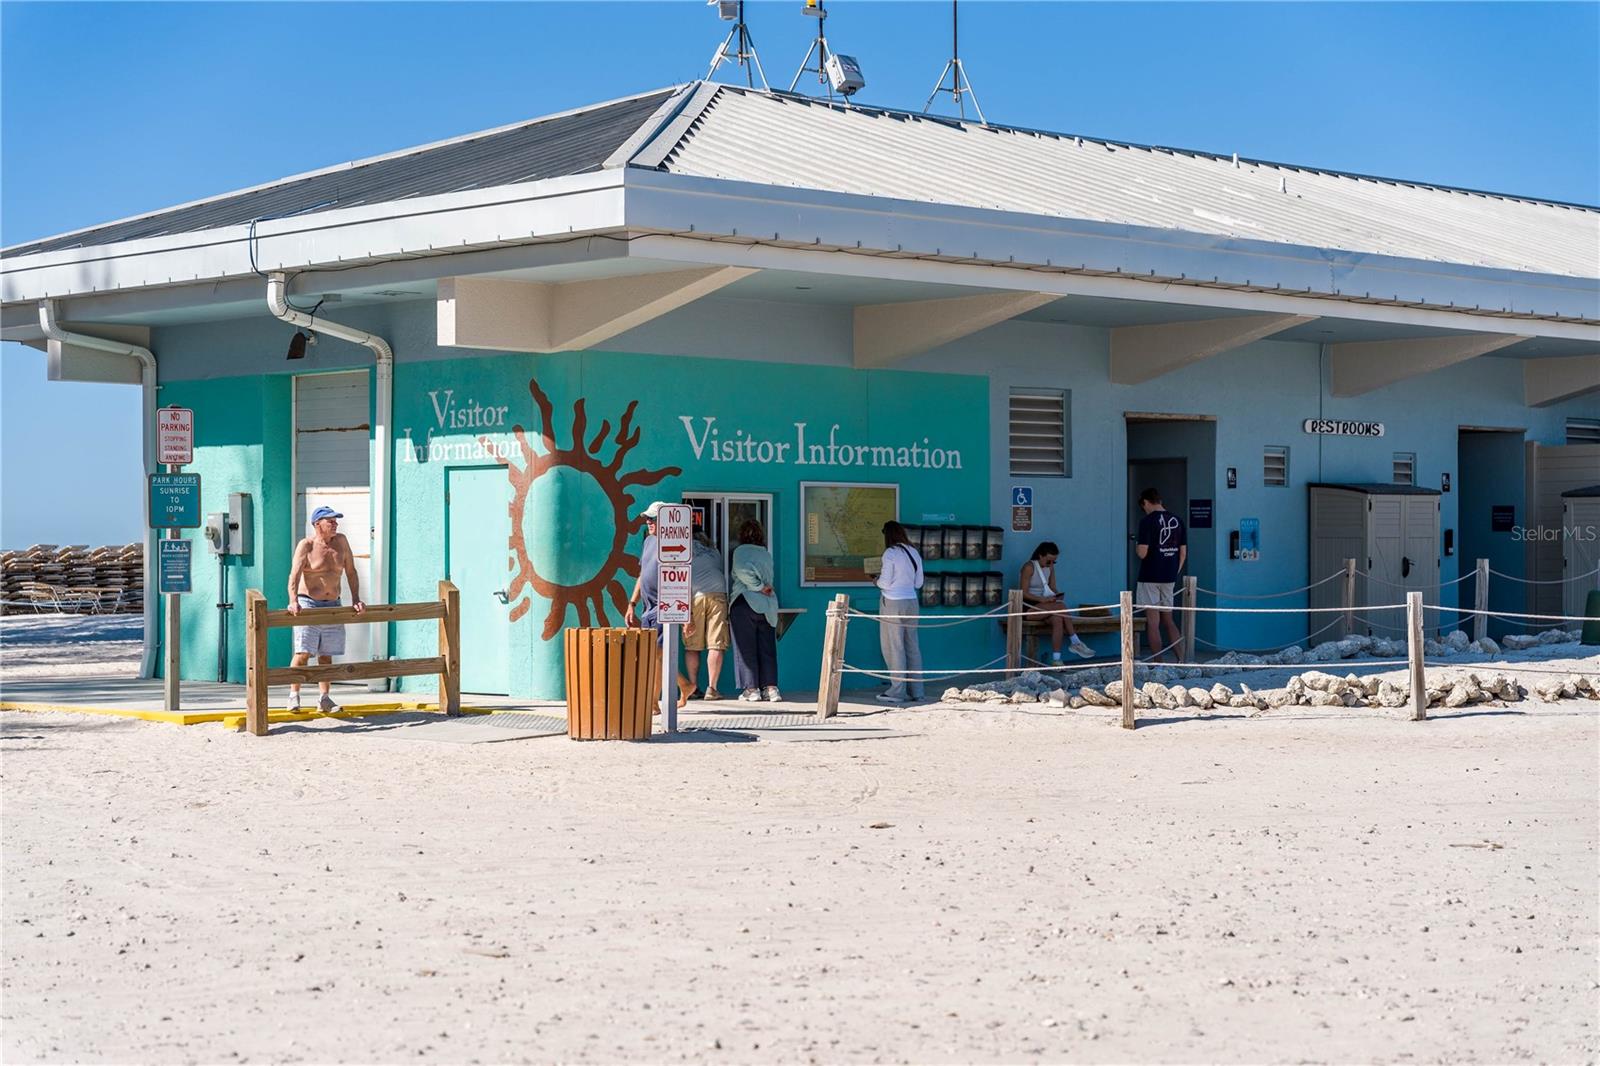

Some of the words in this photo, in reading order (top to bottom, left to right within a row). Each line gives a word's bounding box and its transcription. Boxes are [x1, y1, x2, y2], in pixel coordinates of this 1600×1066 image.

[428, 389, 508, 429] Visitor
[170, 412, 180, 421] NO
[160, 423, 190, 431] PARKING
[1311, 420, 1381, 436] RESTROOMS
[403, 427, 523, 463] Information
[678, 415, 791, 463] Visitor
[793, 422, 962, 469] Information
[152, 476, 170, 484] PARK
[173, 476, 197, 484] HOURS
[159, 487, 190, 495] SUNRISE
[170, 496, 180, 504] TO
[668, 510, 681, 523] NO
[660, 526, 690, 540] PARKING
[662, 570, 688, 582] TOW
